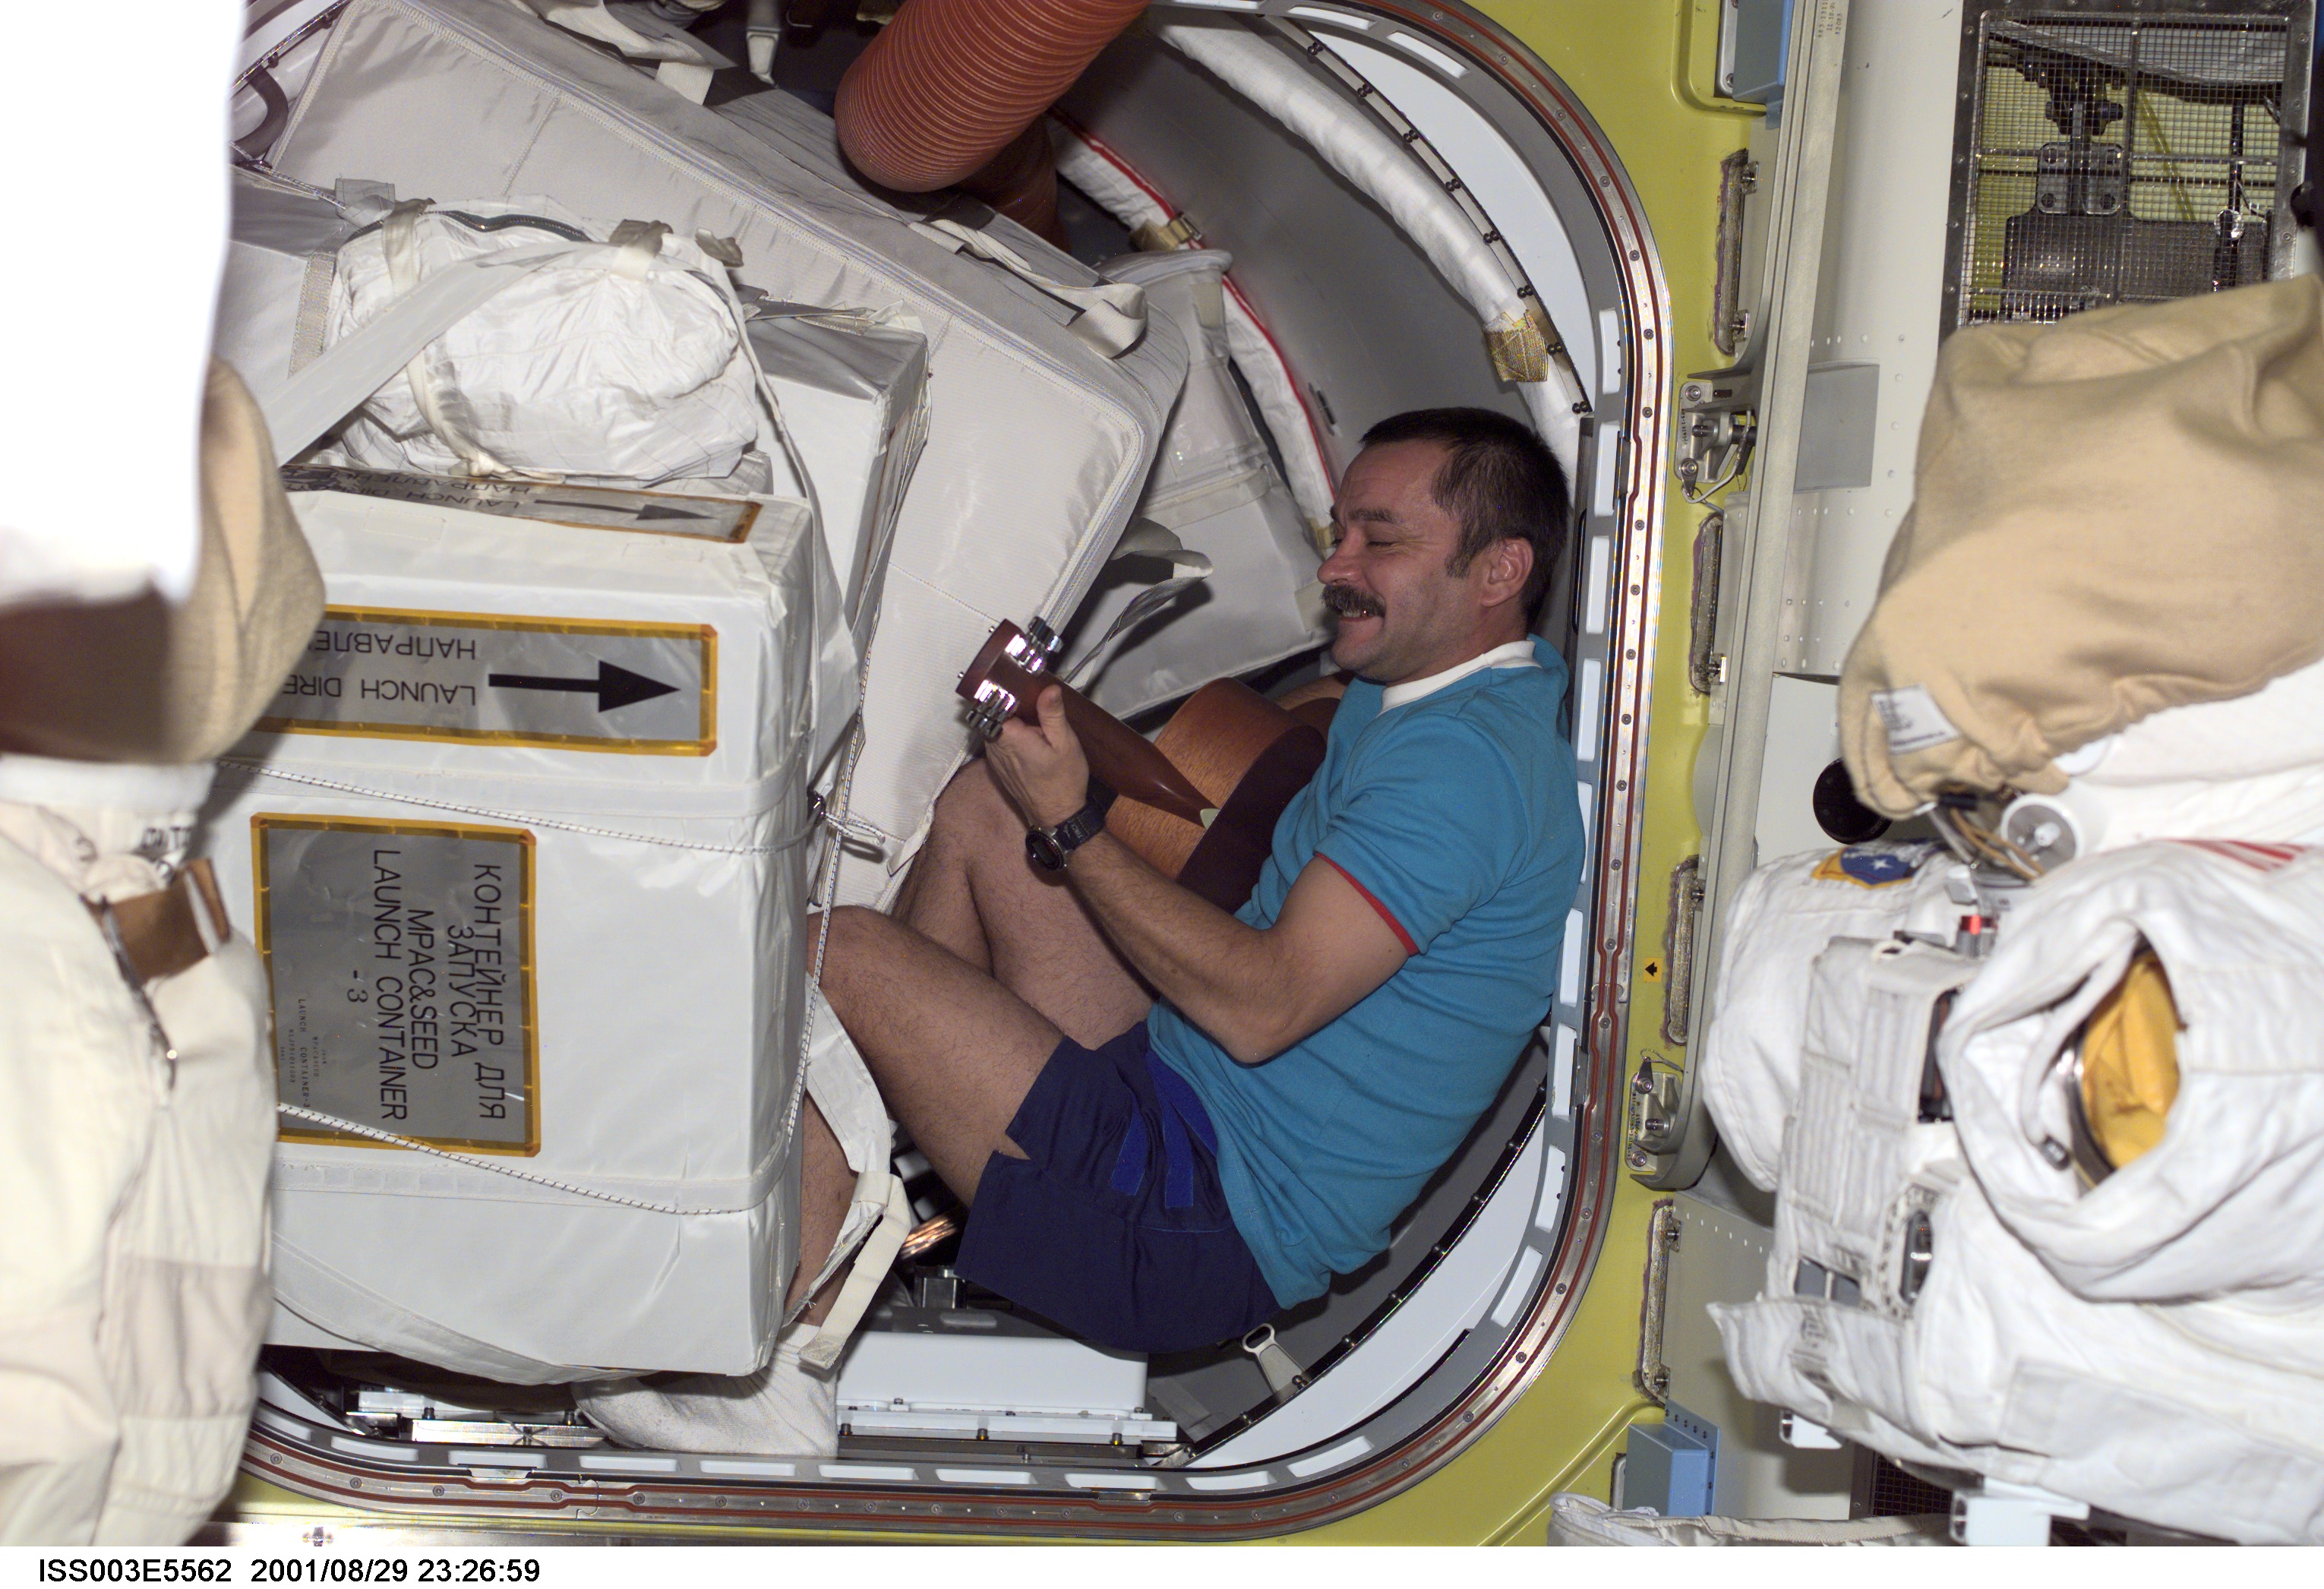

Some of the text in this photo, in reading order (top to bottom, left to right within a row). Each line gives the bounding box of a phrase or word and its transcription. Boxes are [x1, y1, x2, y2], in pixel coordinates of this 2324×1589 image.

[406, 491, 519, 510] LAUNCH
[307, 630, 476, 660] НАПРАВЛЕ
[361, 678, 476, 706] LAUNCH
[298, 999, 307, 1032] LAUNCH
[373, 850, 407, 1120] LAUNCH CONTAINER
[407, 908, 438, 1069] MPAC&SEED
[447, 925, 478, 1057] ЗАПУСКА
[474, 864, 506, 1120] КОНТЕЙНЕР ДЛЯ
